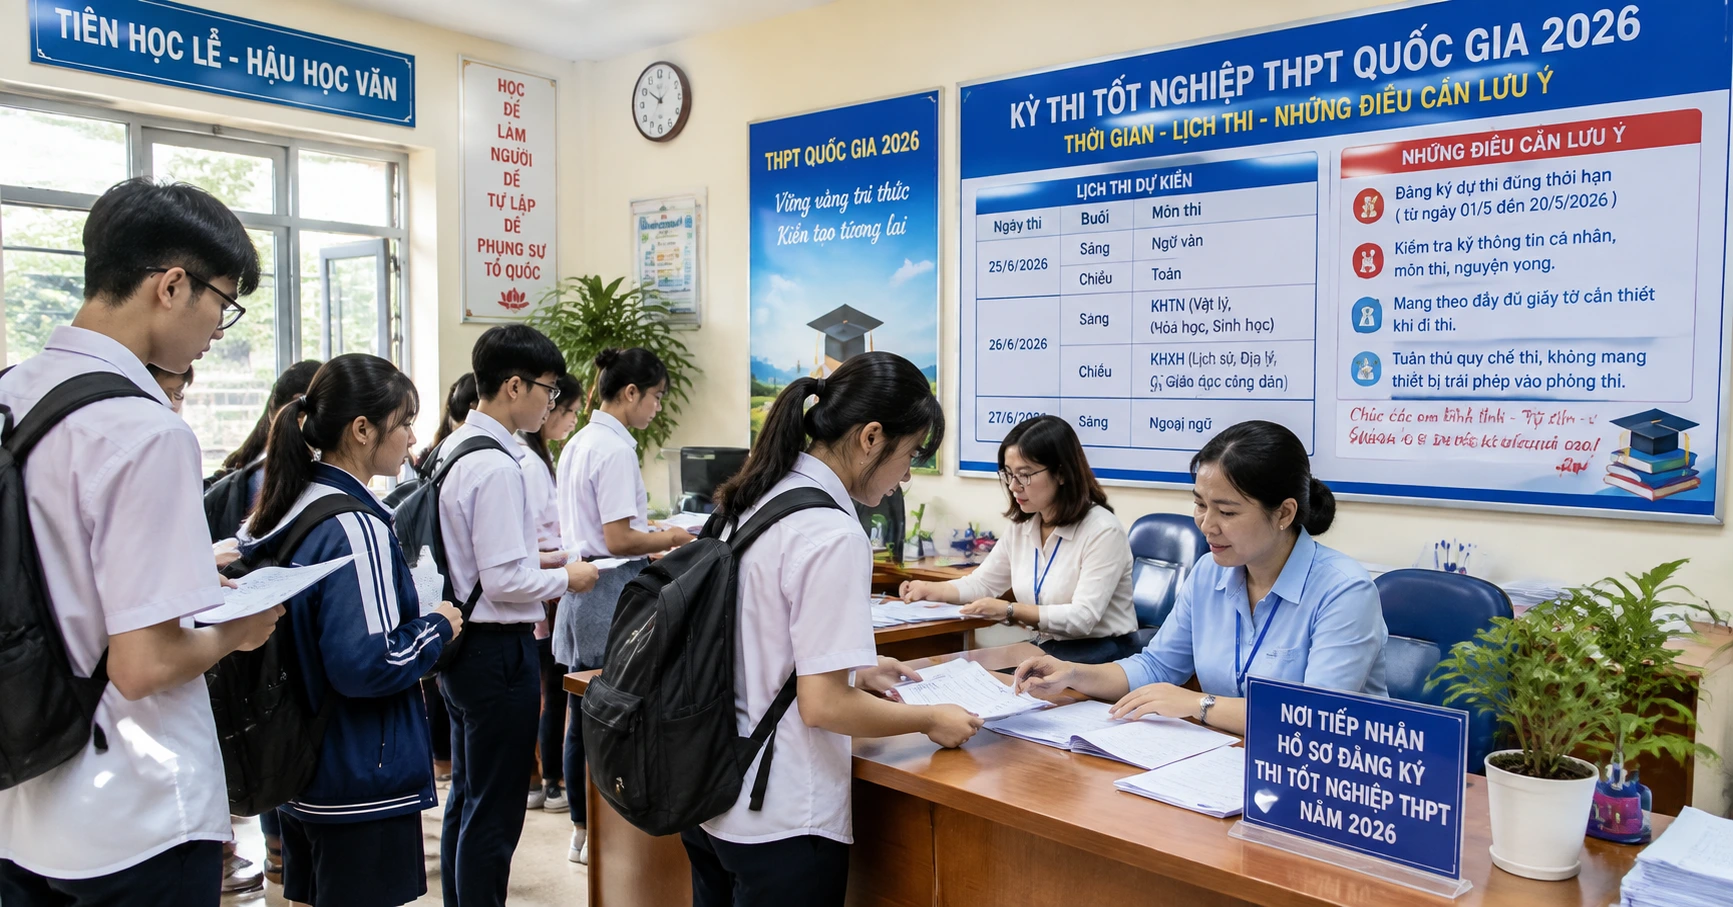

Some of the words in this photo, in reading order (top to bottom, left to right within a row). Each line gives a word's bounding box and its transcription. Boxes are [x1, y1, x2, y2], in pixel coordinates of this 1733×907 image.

[54, 6, 119, 49] TIÊN
[128, 22, 184, 64] HỌC
[229, 55, 239, 64] -
[246, 45, 295, 86] HẬU
[302, 59, 349, 96] HỌC
[355, 67, 398, 102] VĂN
[1046, 92, 1085, 124] THI
[1092, 73, 1142, 117] TỐT
[1150, 60, 1254, 108] NGHIỆP
[1263, 50, 1344, 91] THPT
[1353, 23, 1453, 82] QUỐC
[1464, 22, 1529, 62] GIA
[1541, 4, 1642, 53] 2026
[497, 78, 525, 99] HỌC
[1110, 123, 1155, 148] GIAN
[1172, 115, 1216, 145] LỊCH
[1222, 109, 1253, 134] THI
[1479, 72, 1529, 102] LƯU
[1567, 126, 1606, 149] LƯU
[764, 147, 801, 171] THPT
[804, 137, 846, 167] QUỐC
[850, 137, 878, 159] GIA
[881, 130, 920, 155] 2026
[1109, 178, 1132, 195] THI
[1135, 173, 1158, 195] DỰ
[1436, 181, 1453, 199] ký
[1456, 180, 1476, 197] dự
[1479, 177, 1498, 192] thi
[1581, 169, 1612, 186] hạn
[1183, 202, 1202, 217] thi
[1460, 200, 1492, 217] 01/5
[1529, 192, 1608, 212] 20/5/2026
[813, 223, 836, 247] tạo
[886, 213, 908, 236] lai
[1026, 215, 1042, 230] thi
[477, 237, 524, 257] PHỤNG
[1433, 240, 1453, 252] tra
[1477, 234, 1521, 251] thông
[1525, 232, 1545, 247] tin
[1572, 228, 1617, 245] nhân,
[988, 257, 1048, 273] 25/6/2026
[1428, 261, 1450, 277] thi,
[1513, 258, 1555, 274] yong.
[1151, 298, 1186, 313] KHTN
[1393, 296, 1432, 313] Mang
[1436, 295, 1468, 309] theo
[1212, 318, 1241, 333] Sinh
[1245, 317, 1275, 334] học)
[1393, 318, 1413, 333] khi
[1417, 318, 1430, 332] đi
[1434, 317, 1456, 332] thi.
[988, 338, 1048, 351] 26/6/2026
[1150, 352, 1185, 366] KHXH
[1456, 353, 1484, 367] quy
[1519, 349, 1543, 366] thi,
[1601, 351, 1647, 367] mang
[1427, 374, 1441, 390] bị
[1601, 373, 1626, 389] thi.
[1280, 702, 1313, 728] NƠI
[1317, 706, 1360, 737] TIẾP
[1308, 740, 1333, 764] SƠ
[1254, 759, 1282, 785] THI
[1286, 763, 1321, 794] TỐT
[1325, 776, 1394, 814] NGHIỆP
[1398, 793, 1451, 826] THPT
[1348, 813, 1397, 845] 2026
